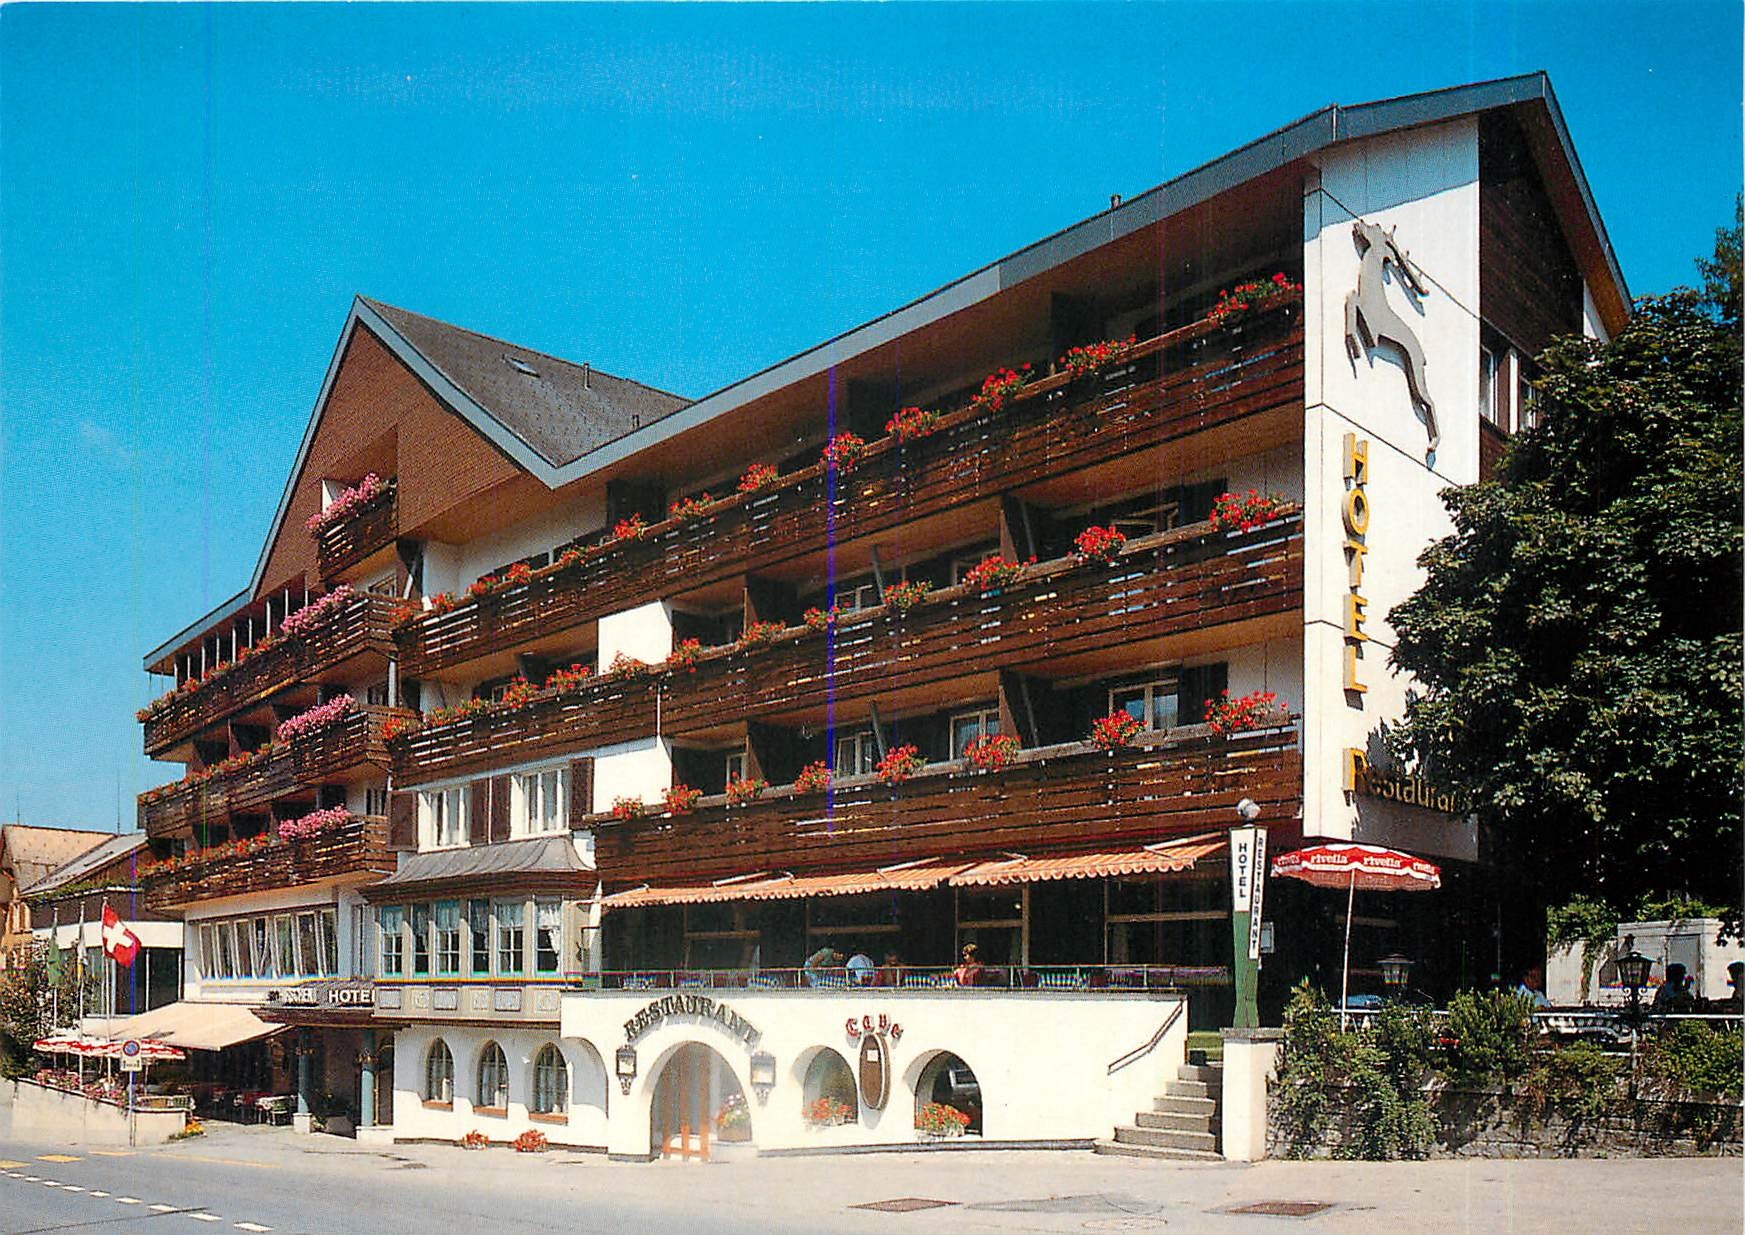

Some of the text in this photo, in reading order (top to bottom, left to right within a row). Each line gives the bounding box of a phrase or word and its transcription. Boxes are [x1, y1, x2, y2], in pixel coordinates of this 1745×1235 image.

[1343, 432, 1369, 694] HOTEL
[1237, 842, 1248, 899] HOTEL
[1311, 853, 1348, 865] rivella
[1363, 856, 1401, 869] rivella
[1251, 837, 1264, 950] RESTAURANT
[623, 995, 764, 1042] RESTAURANT
